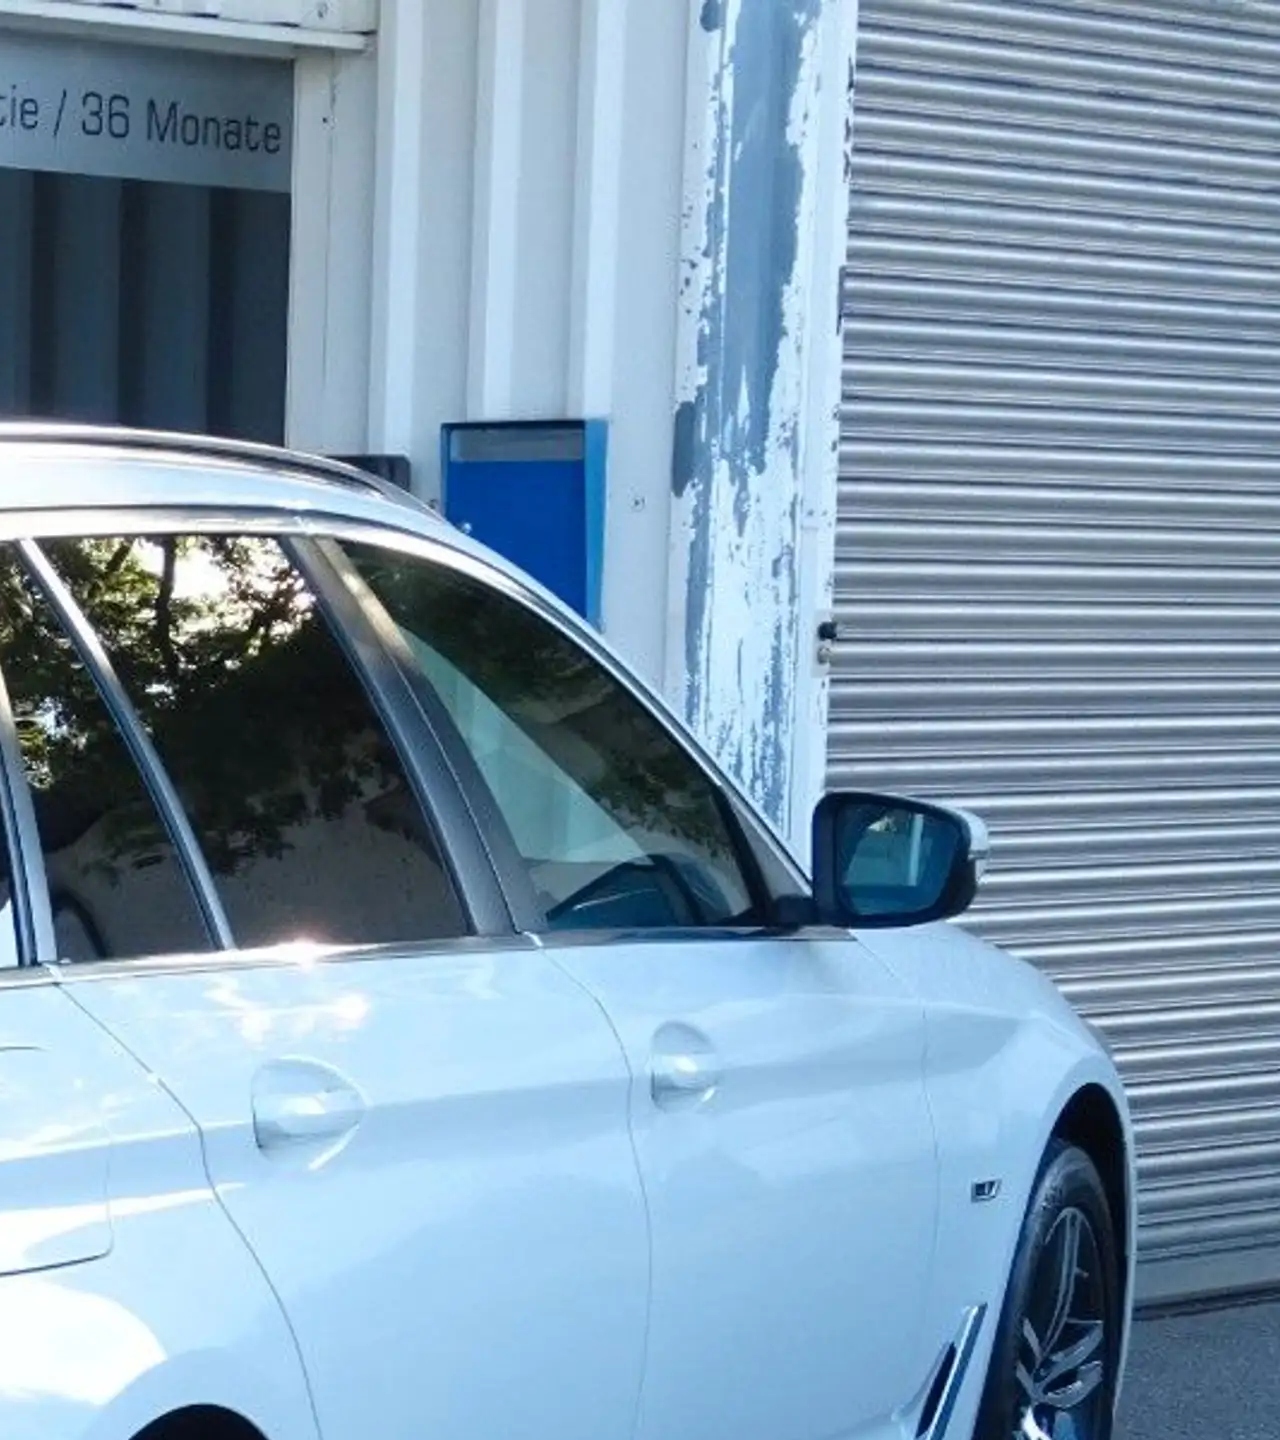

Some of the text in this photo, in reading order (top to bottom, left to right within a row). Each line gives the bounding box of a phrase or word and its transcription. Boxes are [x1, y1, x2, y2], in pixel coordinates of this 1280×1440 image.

[53, 88, 67, 137] /
[81, 90, 130, 139] 36
[146, 98, 282, 154] Monate
